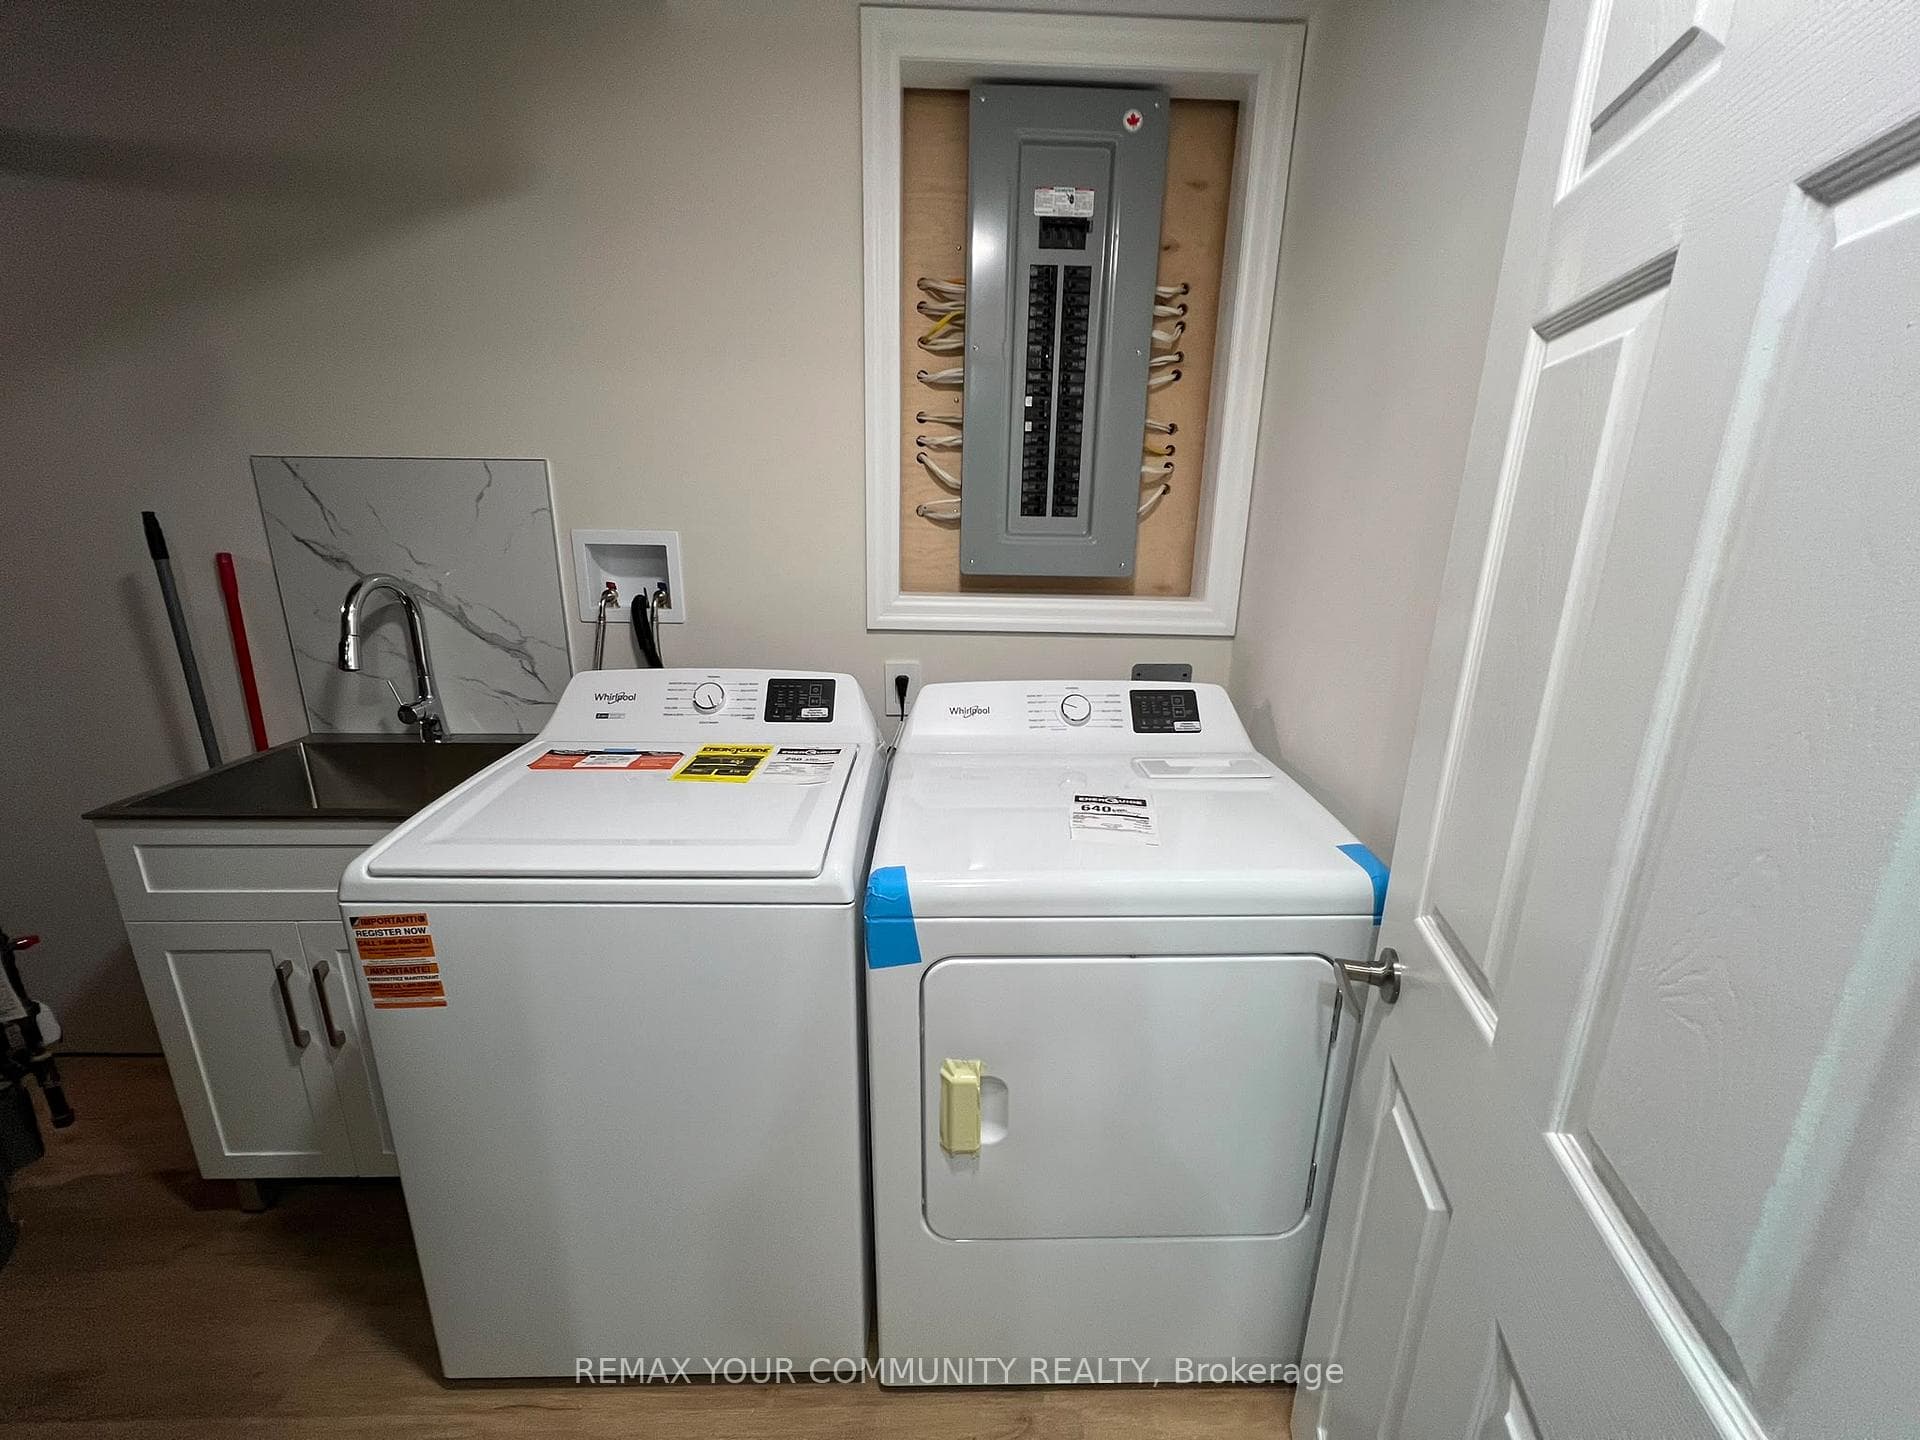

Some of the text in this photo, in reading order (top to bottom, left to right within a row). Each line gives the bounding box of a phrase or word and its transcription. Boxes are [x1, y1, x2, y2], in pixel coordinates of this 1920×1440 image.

[594, 691, 637, 705] Whirlpool
[949, 705, 991, 719] Whirlpool
[1081, 804, 1112, 813] 640
[355, 926, 427, 937] REGISTER NOW
